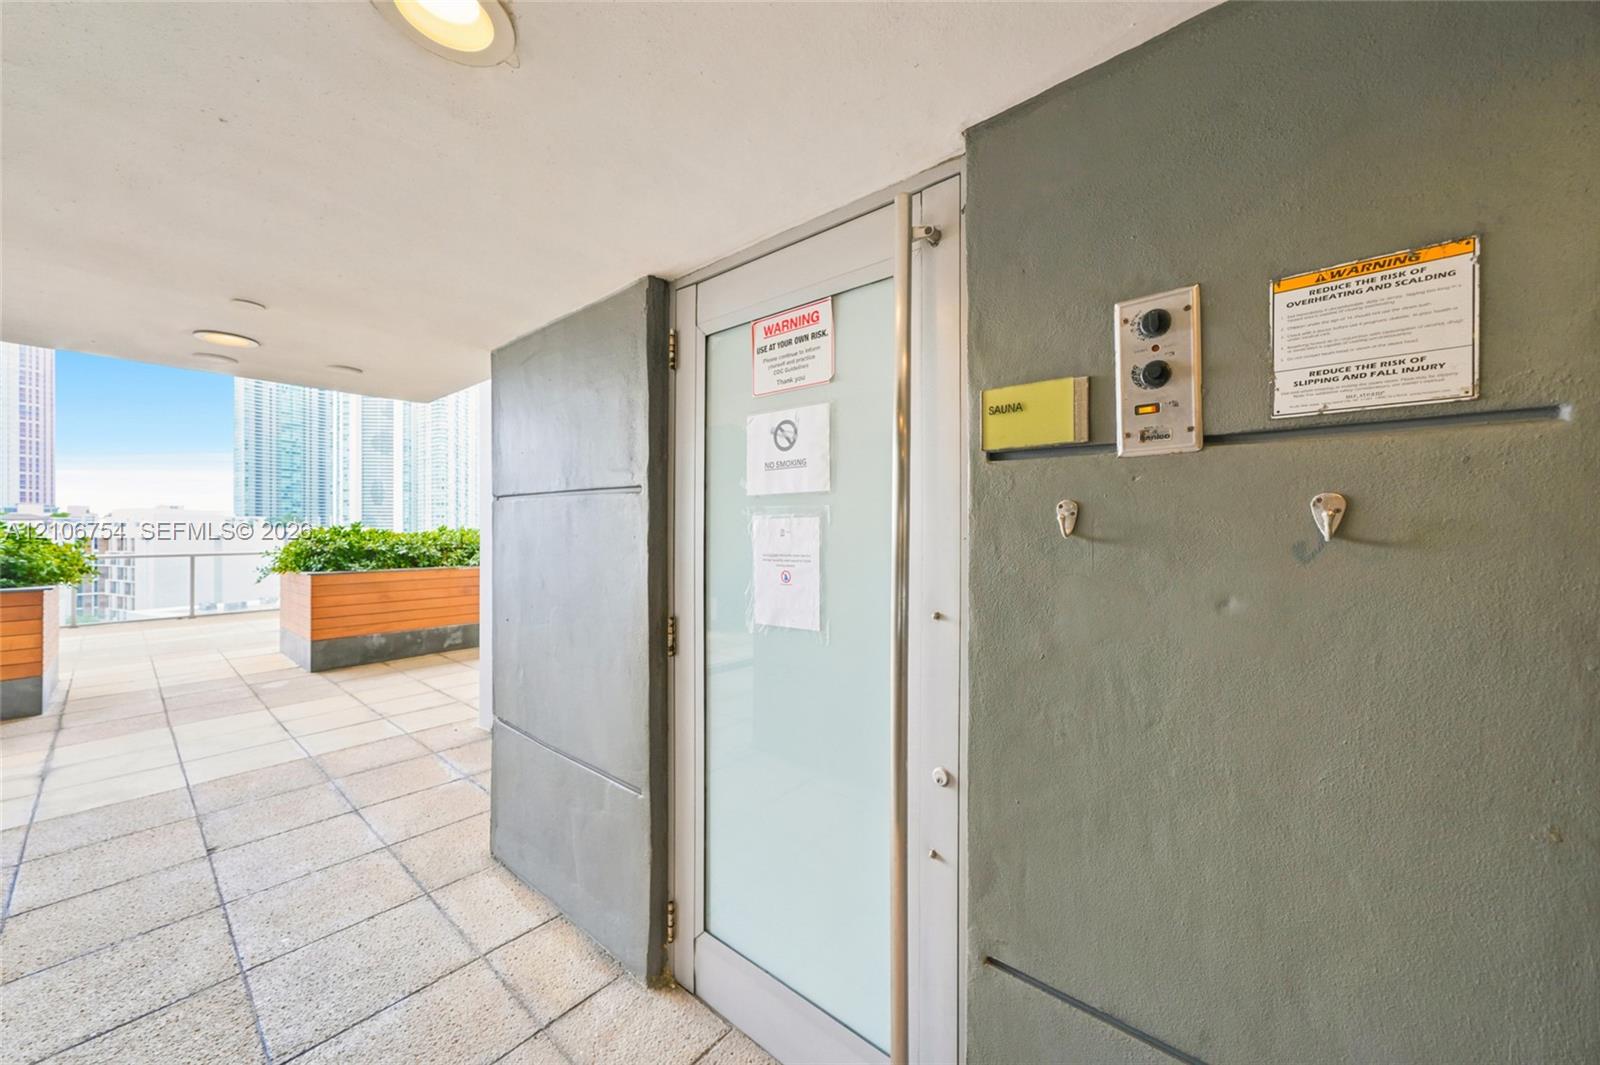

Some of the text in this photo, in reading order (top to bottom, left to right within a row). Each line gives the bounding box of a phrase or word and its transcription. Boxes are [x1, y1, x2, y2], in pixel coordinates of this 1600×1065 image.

[1330, 252, 1422, 280] WARNING
[1286, 269, 1457, 309] OVERHEATING AND SCALDING
[1308, 266, 1427, 296] REDUCE THE RISK OF
[763, 310, 820, 337] WARNING
[756, 329, 829, 355] USE AT YOUR OWN RISK.
[1293, 361, 1447, 388] SLIPPING AND FALL INJURY
[1308, 355, 1427, 377] REDUCE THE RISK OF
[988, 402, 1024, 416] SAUNA
[764, 458, 807, 470] NO SMOKING
